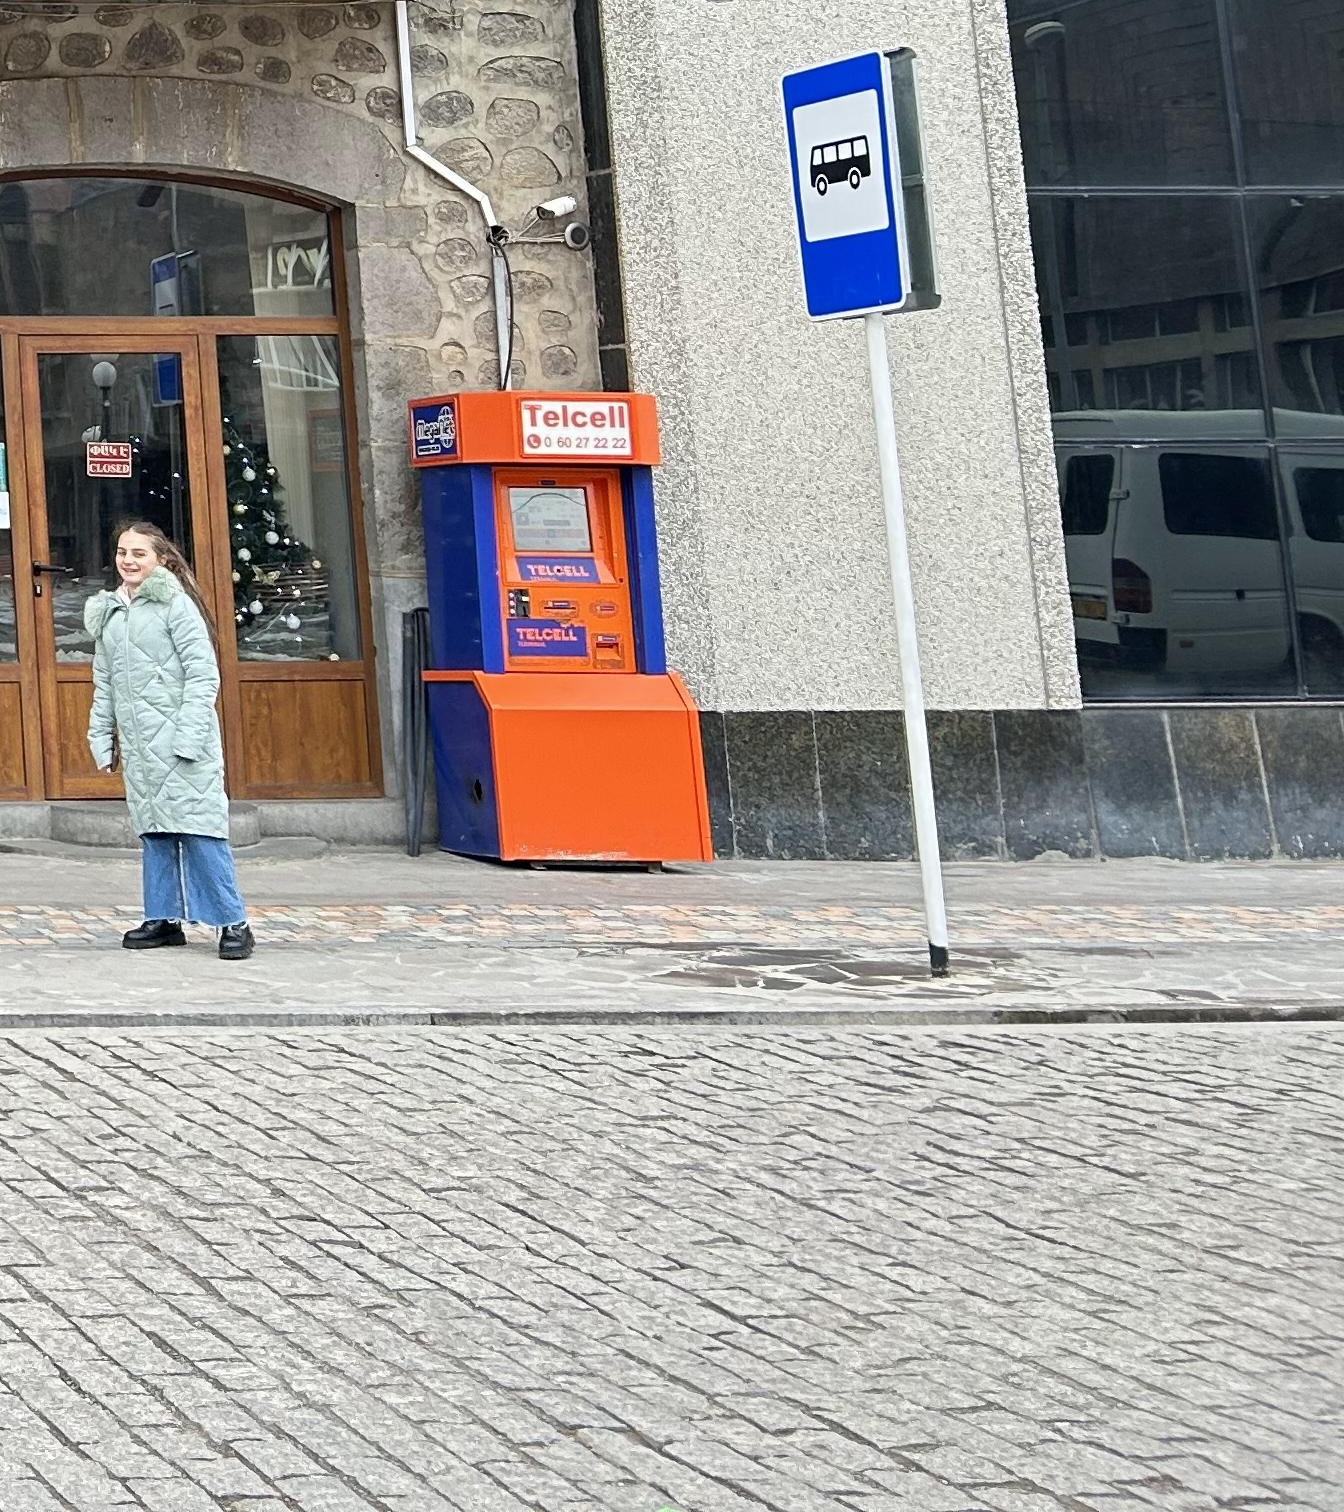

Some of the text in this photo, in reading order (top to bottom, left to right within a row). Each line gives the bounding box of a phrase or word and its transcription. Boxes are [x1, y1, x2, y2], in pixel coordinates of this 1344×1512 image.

[524, 405, 625, 428] Telcell
[593, 438, 608, 448] 22
[612, 438, 627, 449] 22
[89, 464, 130, 473] CLOSED
[526, 564, 590, 577] TELCELL
[516, 628, 578, 641] TELCELL
